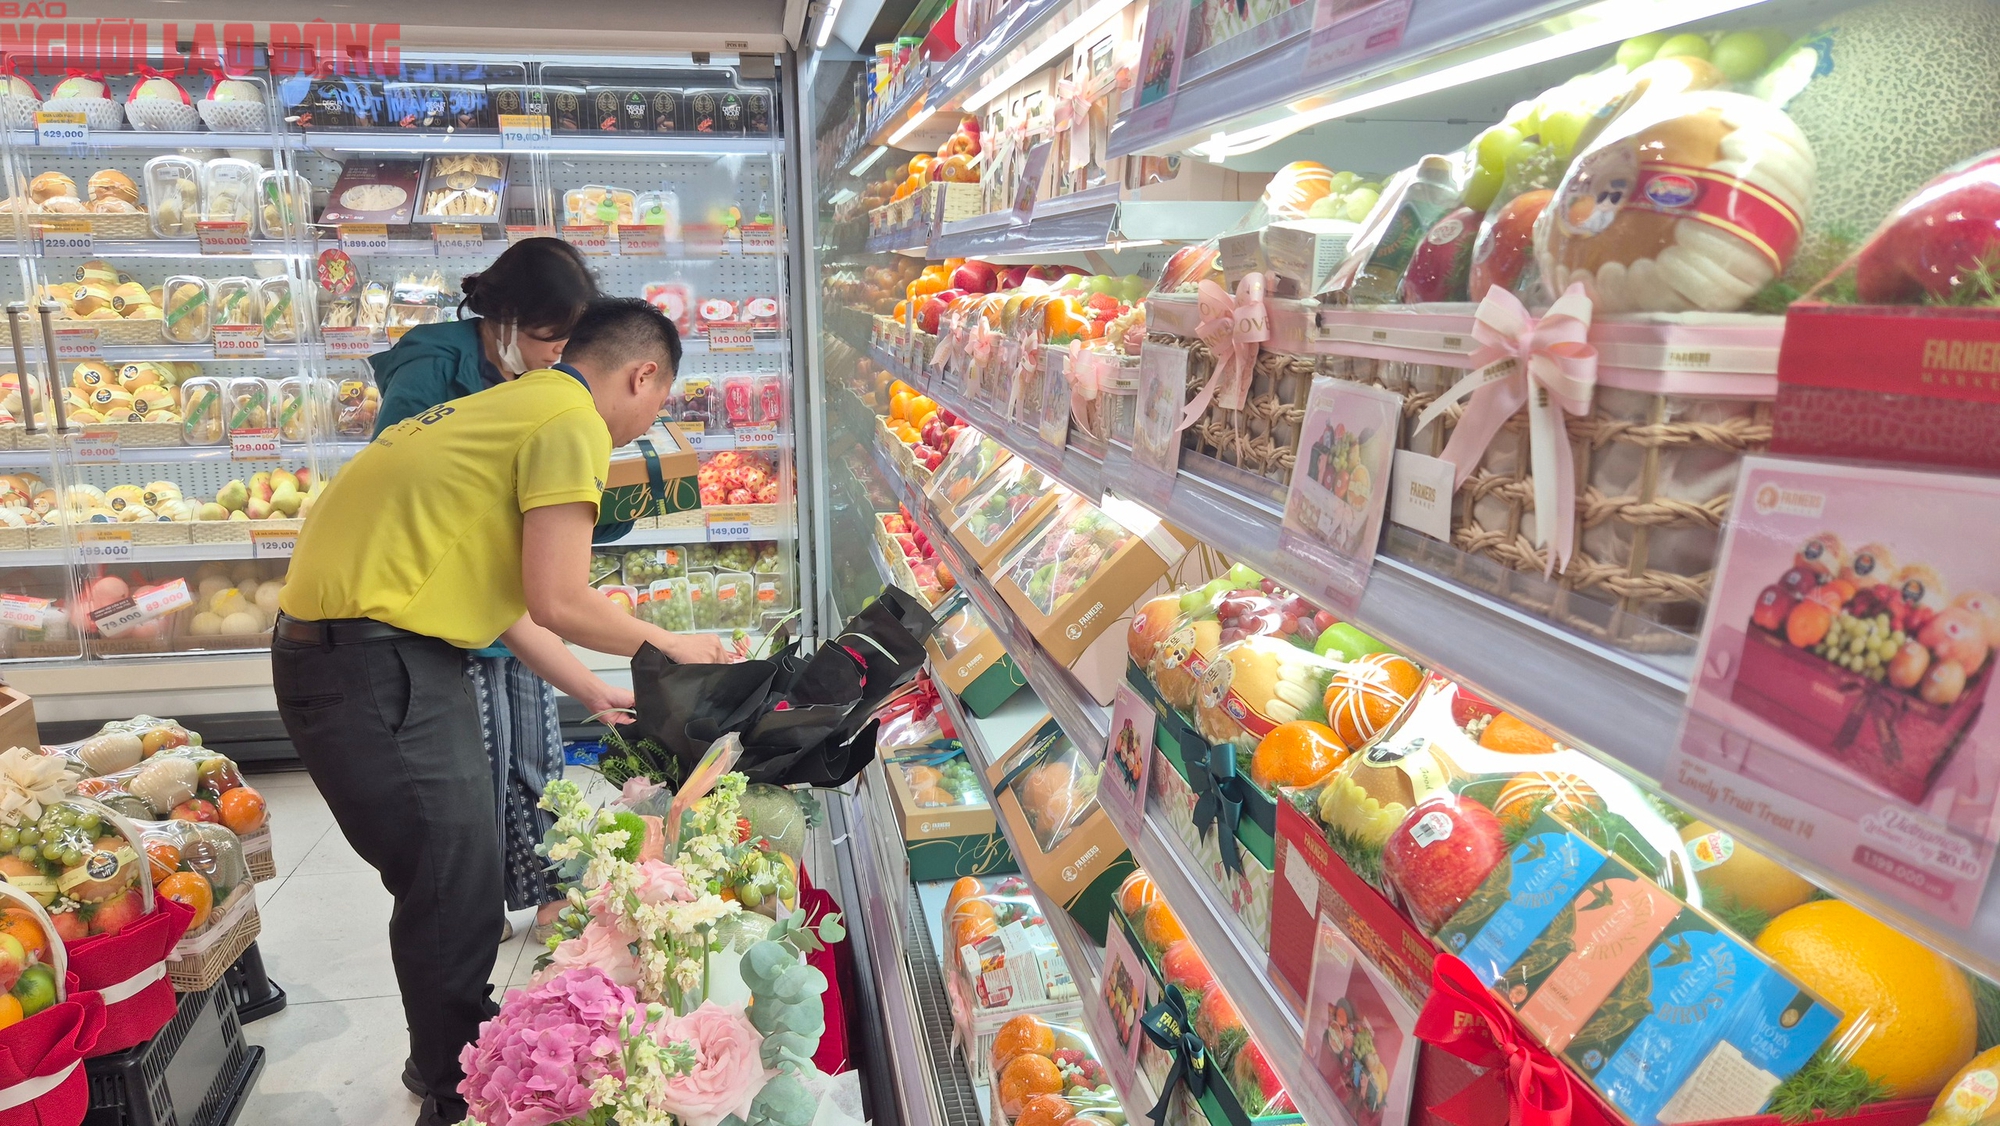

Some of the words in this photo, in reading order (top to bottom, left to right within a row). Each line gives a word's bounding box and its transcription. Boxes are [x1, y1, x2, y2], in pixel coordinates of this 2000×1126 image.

[43, 130, 84, 138] 429,000
[45, 238, 91, 248] 229.000
[204, 236, 248, 246] 396.000
[343, 240, 387, 248] 1.899.000
[749, 239, 775, 247] 32.00
[217, 340, 259, 349] 129.000
[712, 335, 752, 344] 149.000
[59, 344, 97, 353] 69.000
[330, 341, 370, 350] 199.000
[739, 434, 774, 442] 59.000
[80, 447, 116, 457] 69.000
[233, 443, 276, 452] 129.000
[1410, 481, 1436, 503] FARMERS
[711, 526, 749, 536] 149,000
[261, 542, 295, 550] 129,00
[145, 591, 184, 612] 89.000
[3, 611, 36, 622] 25.000
[1078, 601, 1104, 626] FARMERS
[102, 611, 142, 631] 79.000
[1678, 768, 1718, 803] Lovely
[1722, 786, 1754, 814] Fruit
[1758, 801, 1794, 832] Treat
[1074, 844, 1100, 869] FARMERS
[1656, 991, 1725, 1026] BIRD'S
[1707, 942, 1737, 994] NEST
